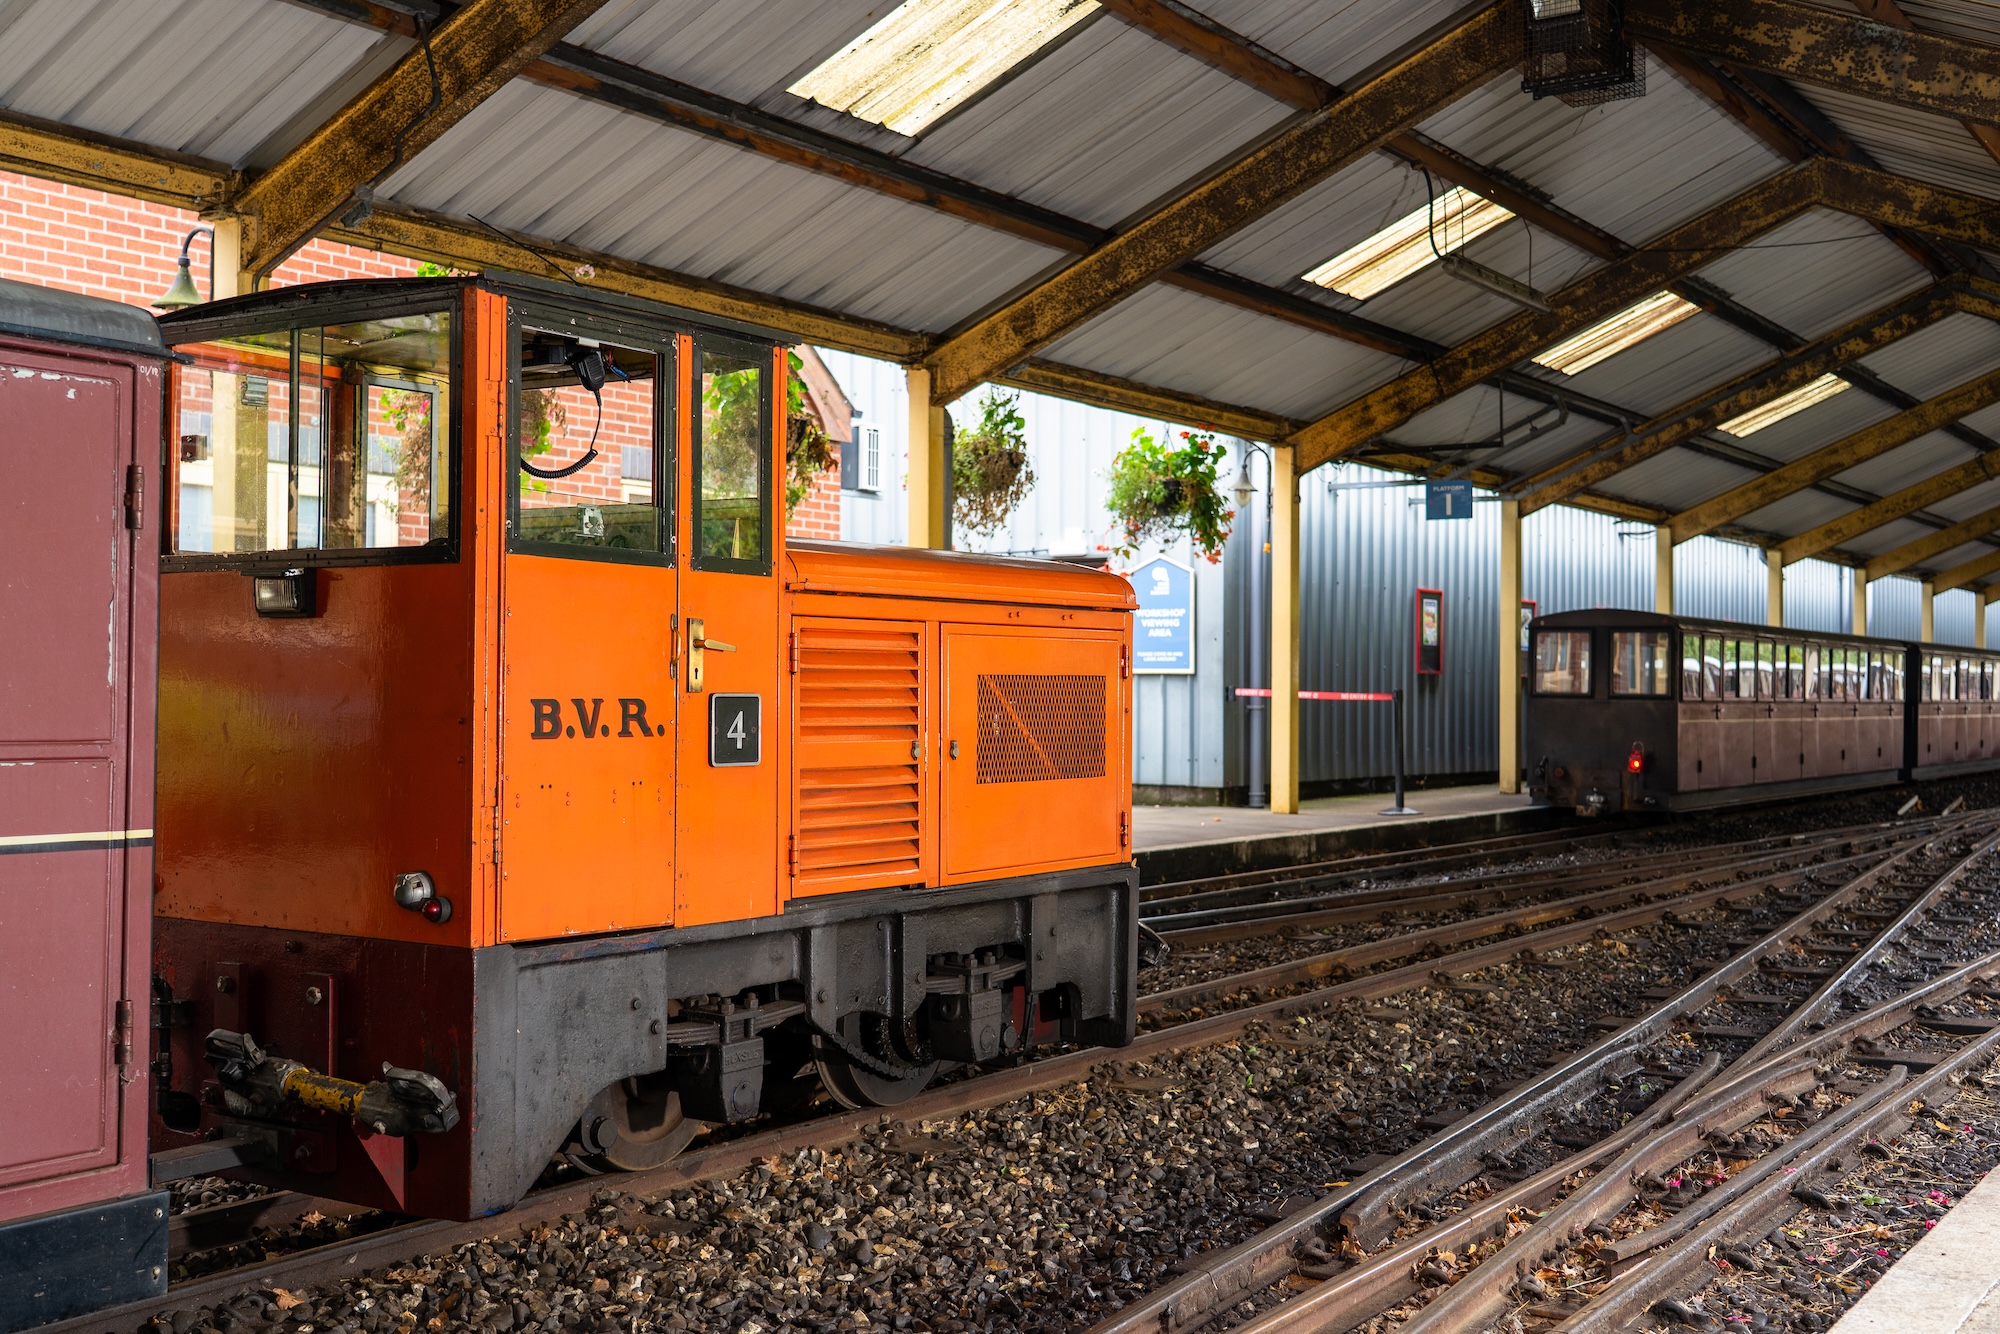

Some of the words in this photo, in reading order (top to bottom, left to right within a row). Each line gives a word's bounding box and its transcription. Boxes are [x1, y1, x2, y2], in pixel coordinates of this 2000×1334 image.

[1445, 493, 1452, 516] 1
[1135, 608, 1186, 617] WORKSHOP
[1140, 618, 1180, 627] VIEWING
[1147, 628, 1172, 637] AREA
[530, 698, 666, 739] B.V.R.
[726, 710, 747, 750] 4
